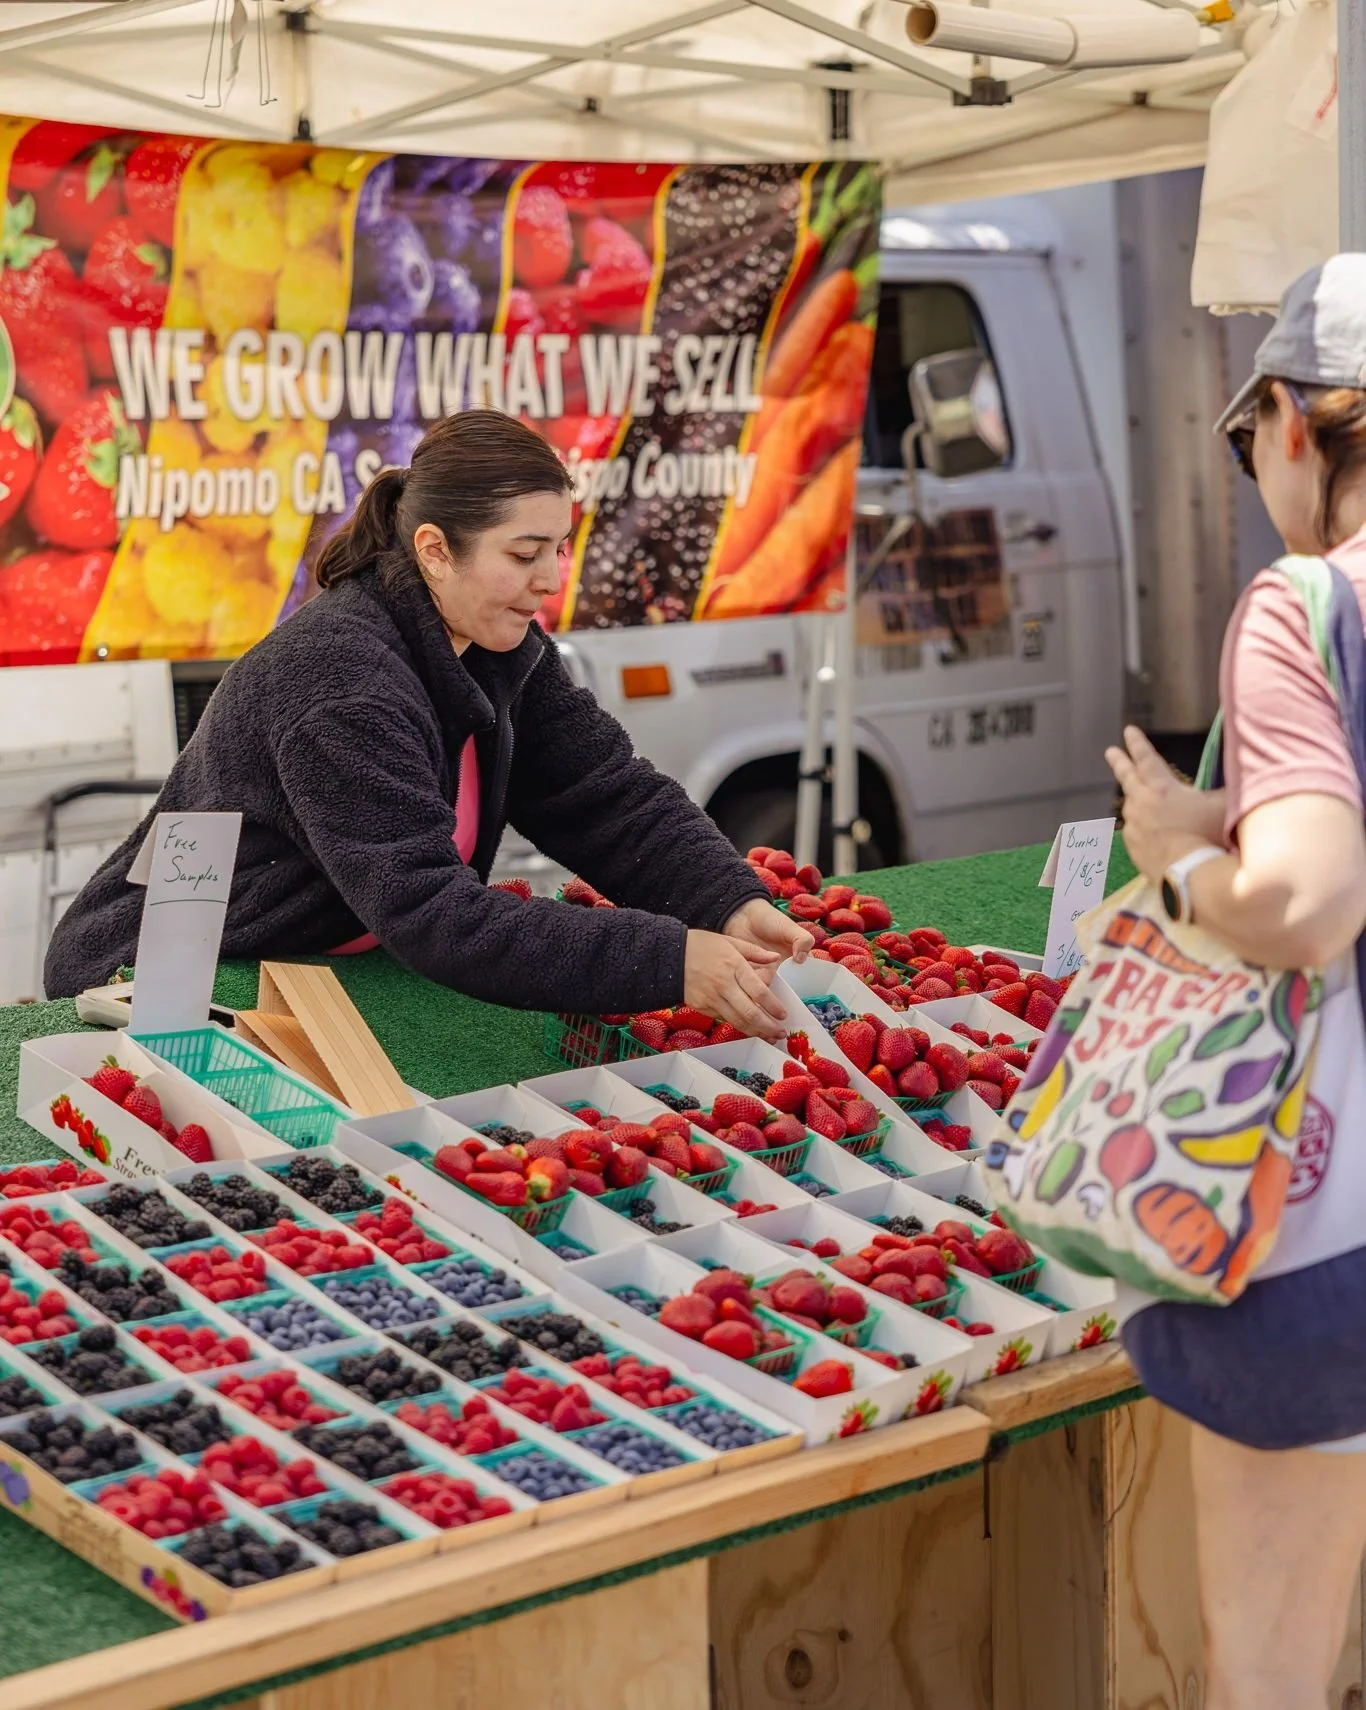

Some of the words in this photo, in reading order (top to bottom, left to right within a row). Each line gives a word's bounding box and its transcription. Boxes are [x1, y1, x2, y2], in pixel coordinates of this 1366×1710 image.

[108, 326, 208, 420] WE
[223, 328, 405, 421] GROW
[414, 332, 571, 419] WHAT
[579, 333, 662, 418] WE
[664, 333, 763, 414] SELL
[116, 453, 279, 532] Nipomo
[293, 451, 346, 514] CA
[564, 446, 630, 514] ispo
[632, 441, 757, 509] County
[163, 820, 198, 851] Free
[1066, 826, 1100, 848] Berries
[163, 854, 219, 892] Samples
[112, 1157, 137, 1179] Stra
